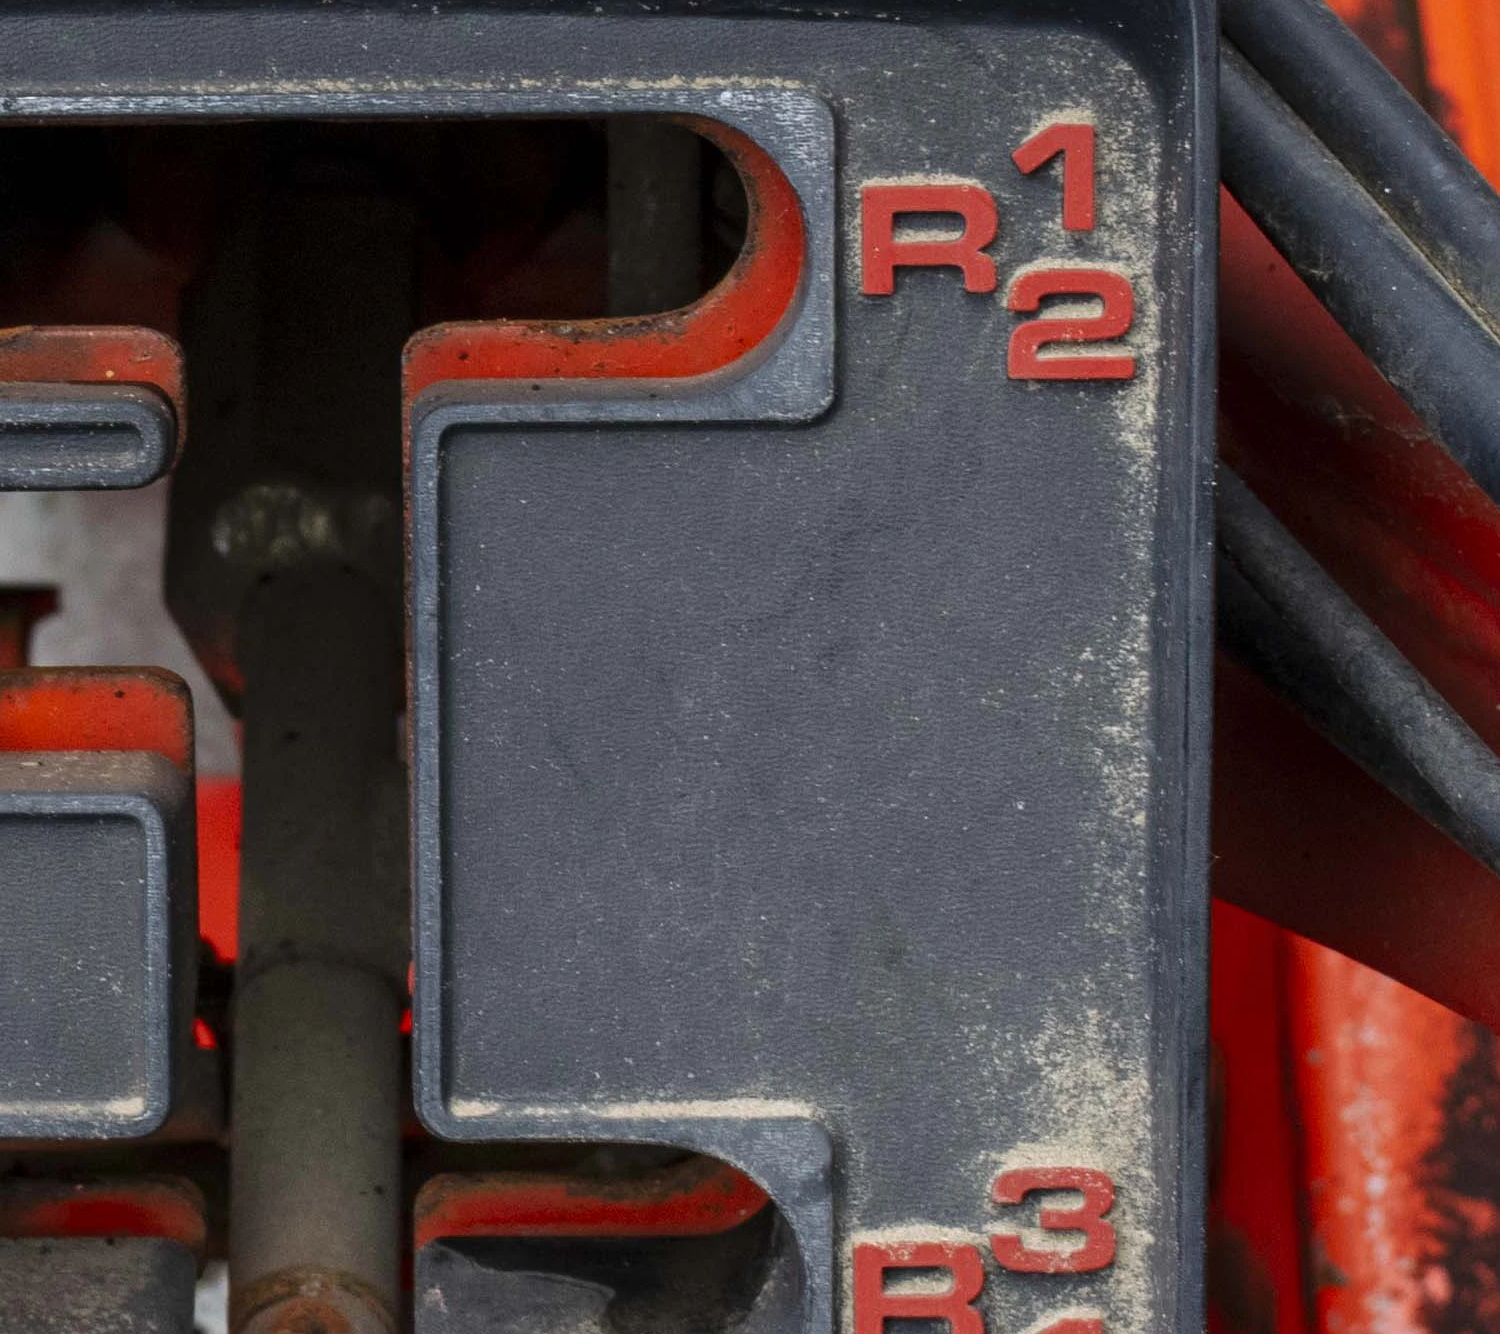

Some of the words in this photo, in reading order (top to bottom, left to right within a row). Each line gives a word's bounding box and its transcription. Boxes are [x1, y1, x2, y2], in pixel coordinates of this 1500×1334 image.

[1011, 123, 1095, 231] 1
[862, 185, 998, 295] R
[1007, 268, 1135, 379] 2
[990, 1167, 1116, 1272] 3
